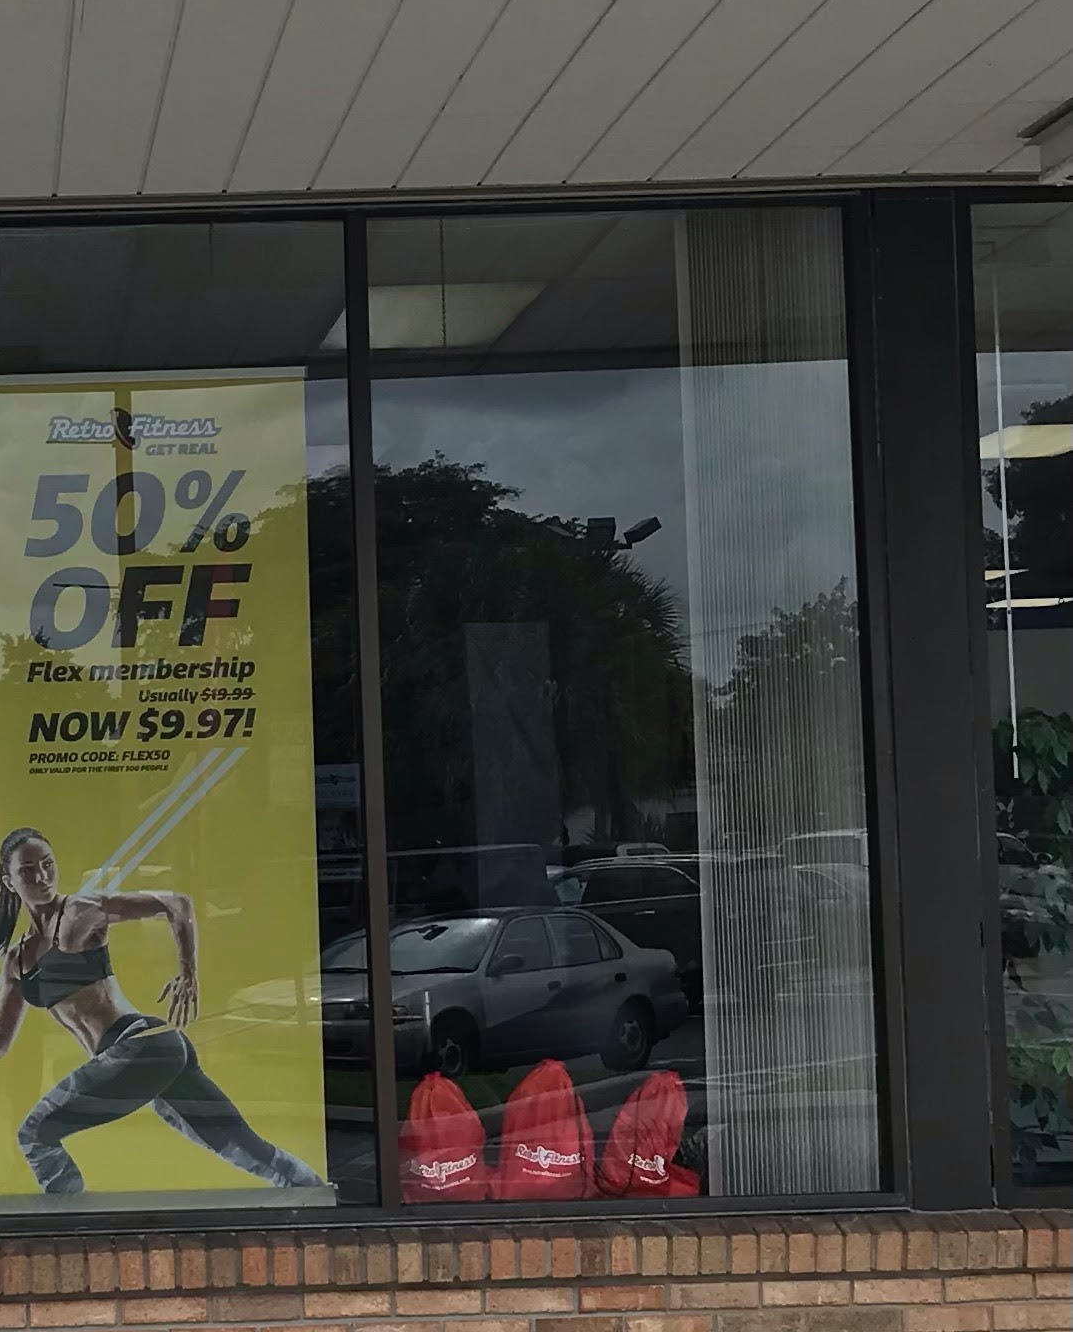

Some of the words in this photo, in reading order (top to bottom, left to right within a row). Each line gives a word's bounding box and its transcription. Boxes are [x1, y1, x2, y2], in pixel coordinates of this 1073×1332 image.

[49, 416, 115, 440] Retro
[129, 414, 222, 439] Fitness
[146, 444, 177, 456] GET
[178, 443, 217, 455] REAL
[24, 470, 251, 557] 50%
[29, 563, 252, 651] OFF
[27, 661, 84, 683] Flex
[89, 657, 255, 682] membership
[138, 689, 199, 704] Usually
[200, 687, 255, 702] $19.99
[29, 711, 131, 743] NOW
[137, 707, 256, 742] $9.97!
[29, 752, 78, 764] PROMO
[80, 751, 119, 763] CODE:
[121, 749, 170, 762] FLEX50
[104, 765, 125, 773] FIRST
[140, 764, 168, 772] PEOPLE
